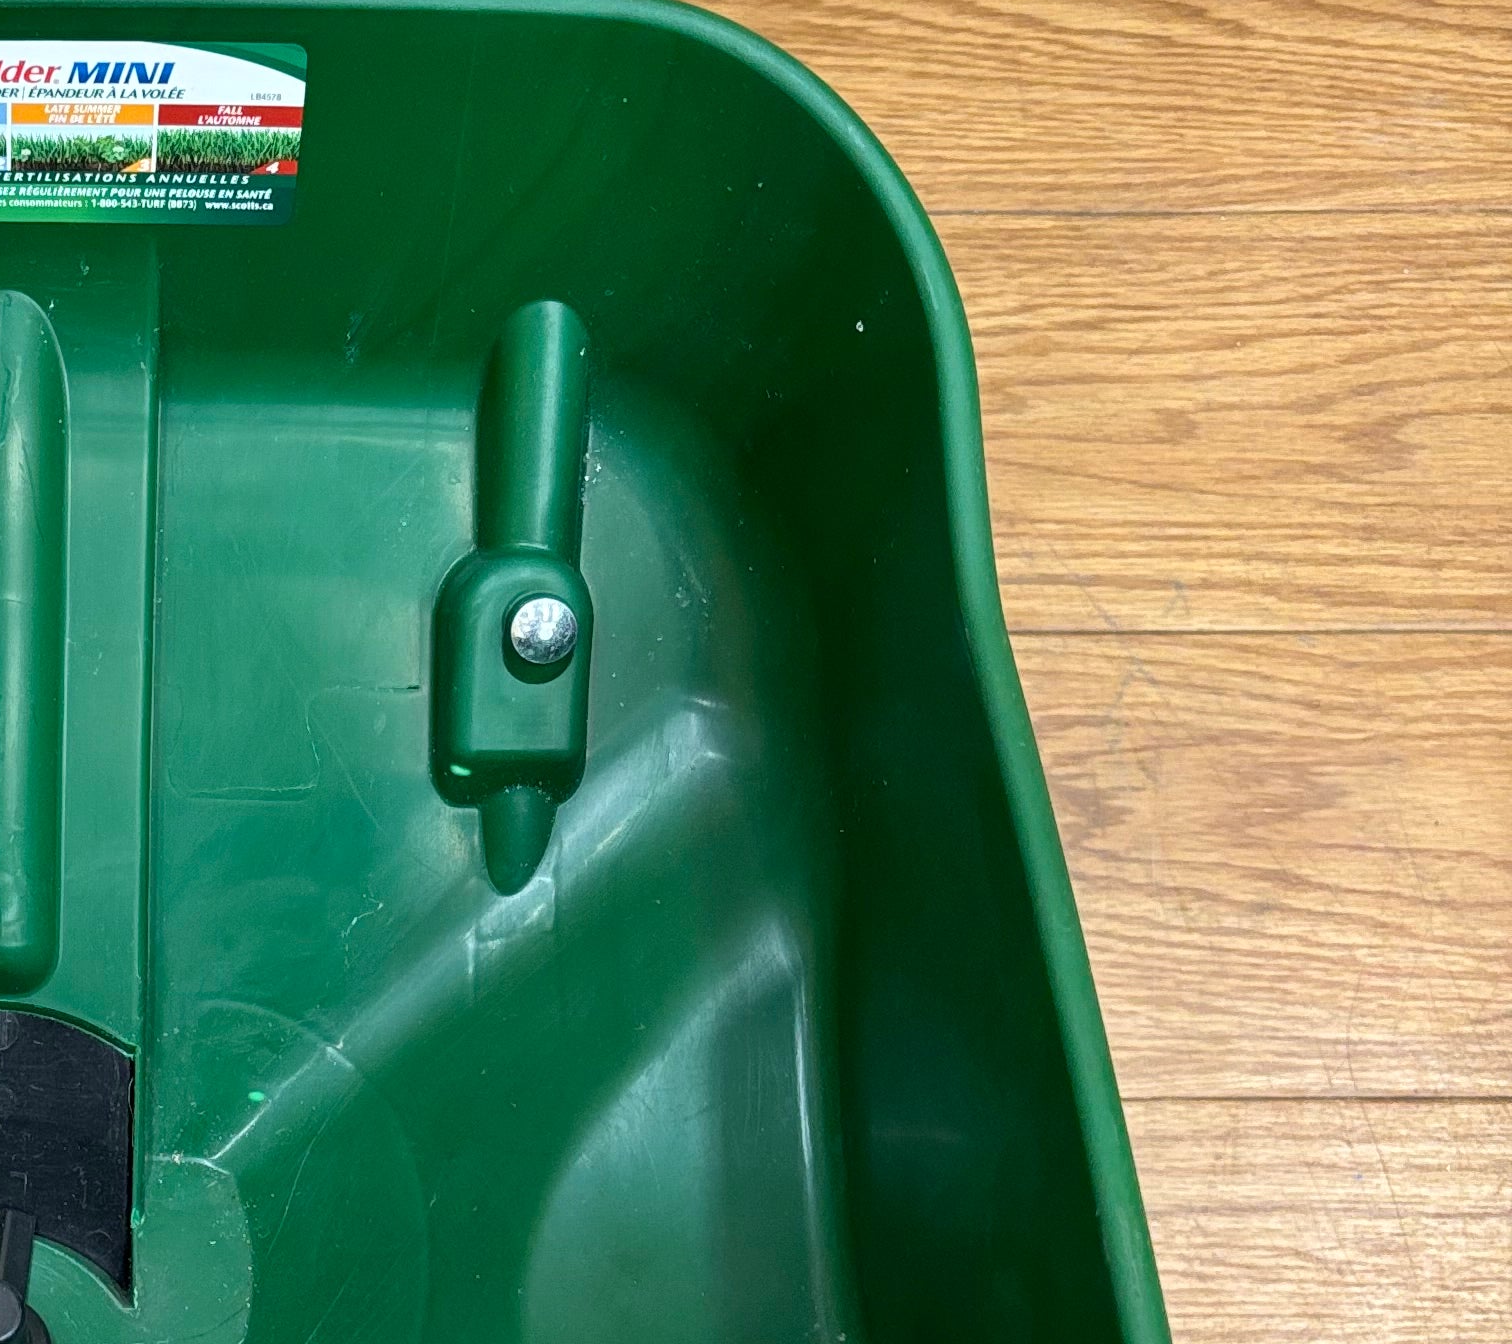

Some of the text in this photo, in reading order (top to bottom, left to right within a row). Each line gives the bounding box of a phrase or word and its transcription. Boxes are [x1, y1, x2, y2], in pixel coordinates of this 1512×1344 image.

[67, 61, 175, 84] MINI
[28, 85, 104, 99] ÉPANDEUR
[107, 86, 117, 99] À
[120, 89, 138, 99] LA
[141, 87, 186, 100] VOLÉE
[44, 104, 121, 115] LATE SUMMER
[217, 106, 243, 116] FALL
[48, 114, 67, 124] FIN
[70, 114, 88, 124] DE
[197, 116, 261, 126] L'AUTOMNE
[138, 159, 150, 172] 3
[265, 161, 280, 174] 4
[145, 174, 251, 185] ANNUELLES
[18, 185, 107, 197] RÉGULIÈREMENT
[110, 188, 141, 197] POUR
[144, 188, 167, 198] UNE
[169, 188, 216, 199] PELOUSE
[218, 189, 233, 199] EN
[236, 188, 273, 199] SANTÉ
[9, 199, 82, 208] consommateurs
[205, 201, 274, 211] www.scotts.ca
